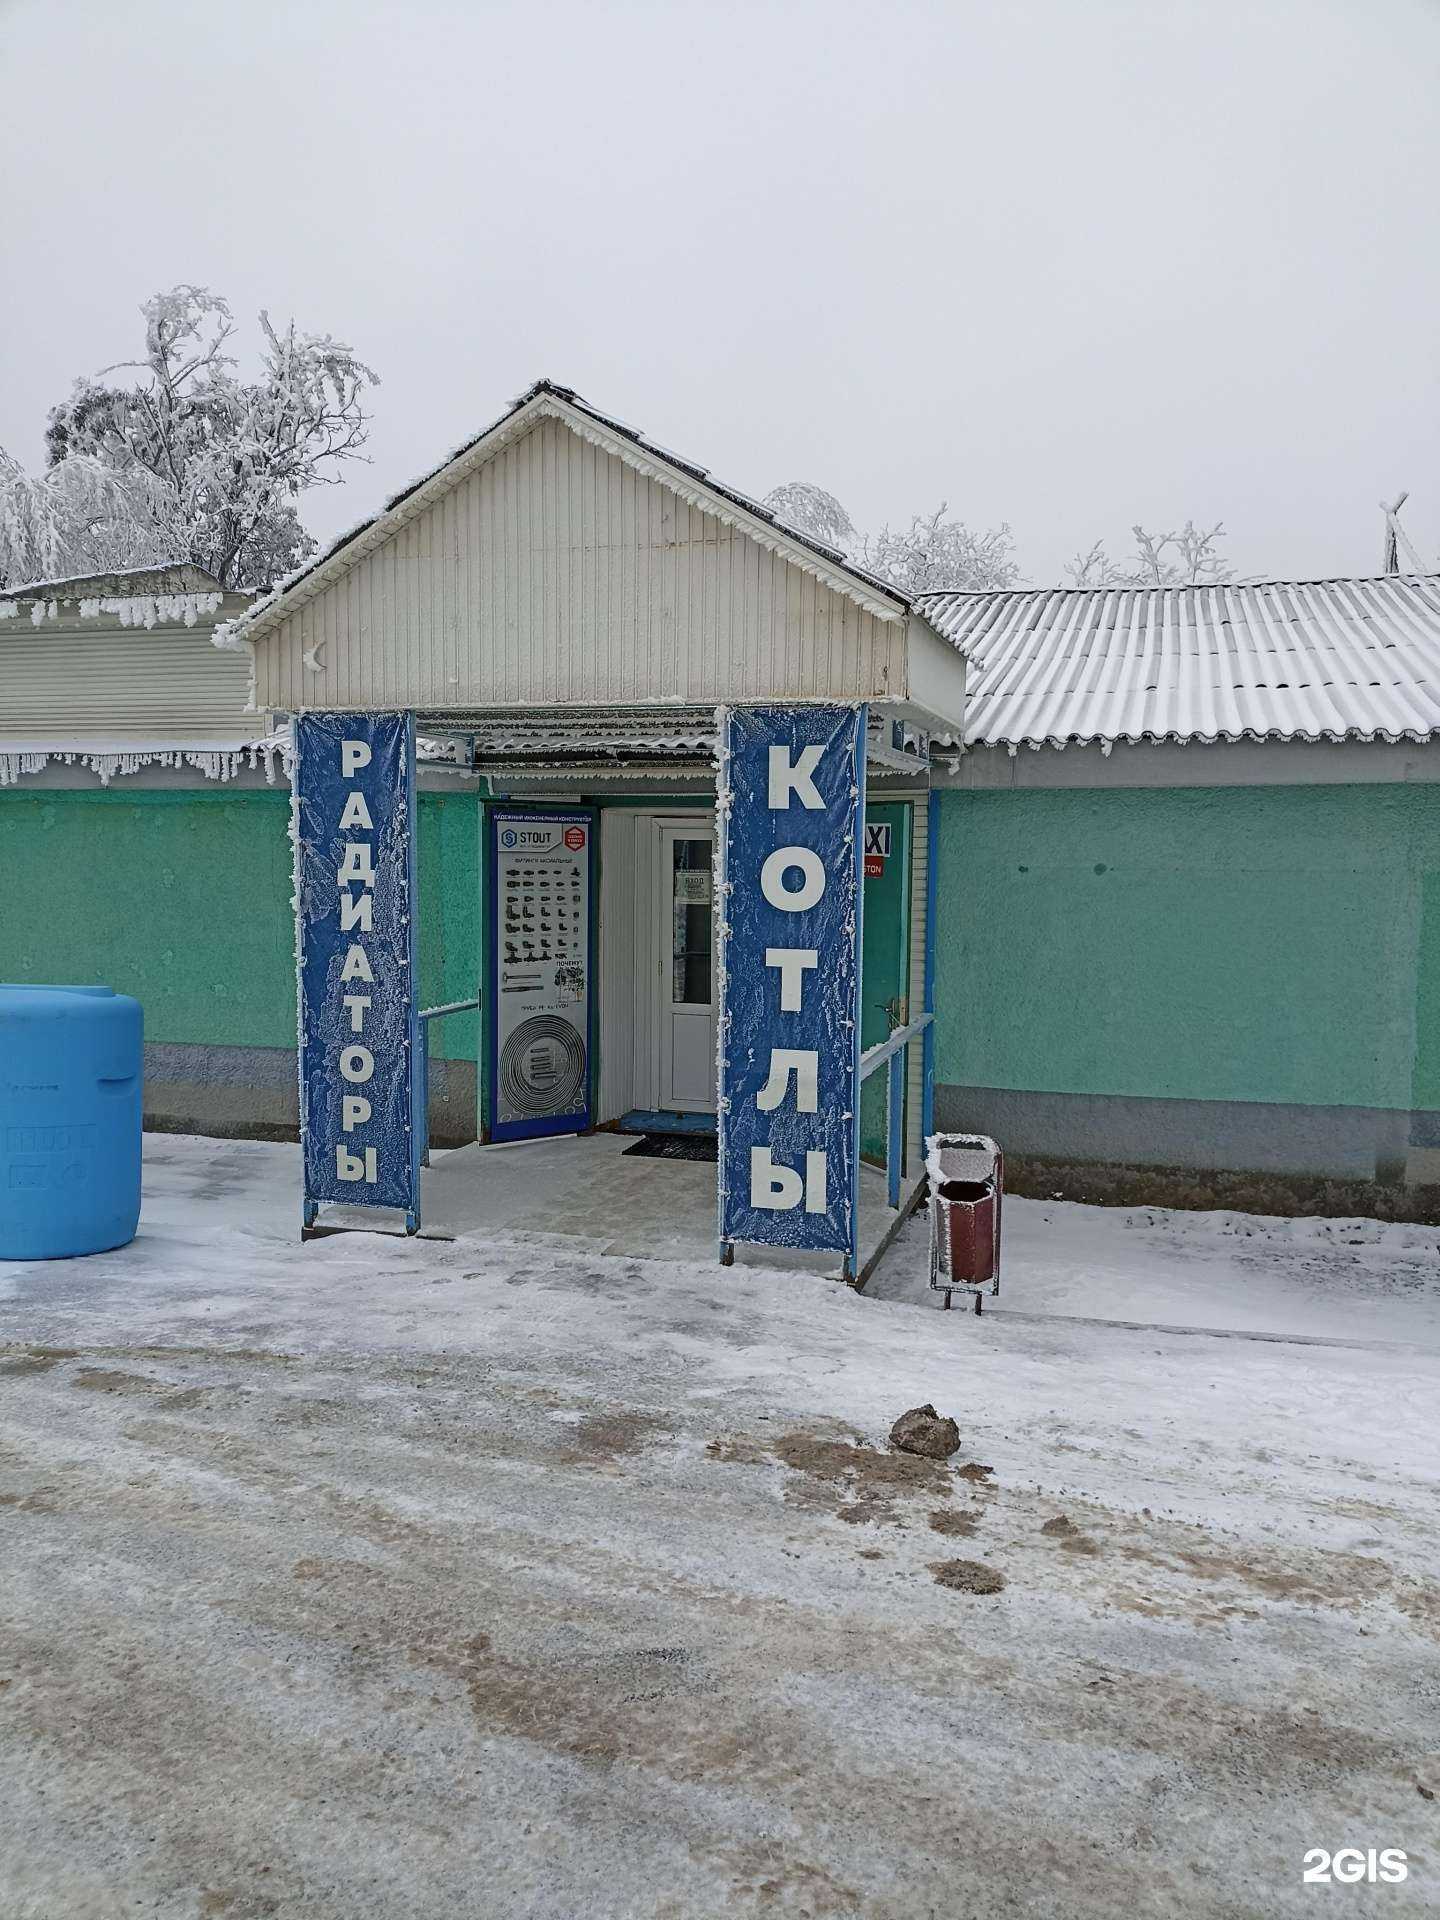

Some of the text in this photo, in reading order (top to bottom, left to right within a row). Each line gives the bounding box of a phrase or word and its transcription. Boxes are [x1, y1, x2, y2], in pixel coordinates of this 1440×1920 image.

[336, 740, 378, 1183] РАДИАТОРЫ
[520, 832, 551, 843] STOUT
[750, 745, 827, 1215] КОТЛЫ
